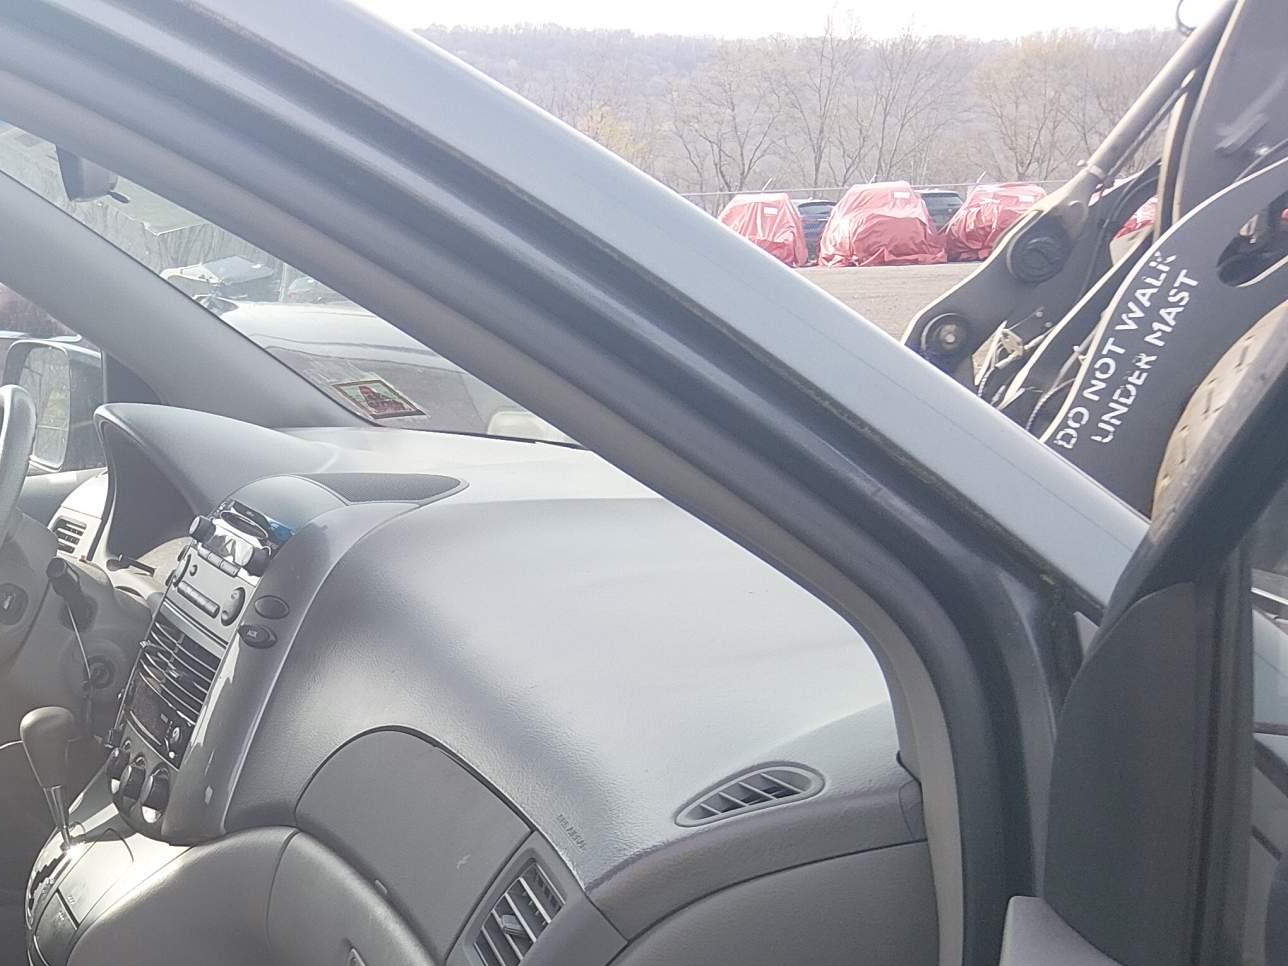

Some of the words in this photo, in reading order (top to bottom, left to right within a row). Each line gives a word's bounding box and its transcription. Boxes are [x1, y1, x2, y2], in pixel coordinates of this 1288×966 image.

[1053, 407, 1089, 449] DO
[1083, 338, 1126, 404] NOT
[1115, 251, 1177, 331] WALK
[1092, 353, 1157, 444] UNDER
[1145, 270, 1199, 347] MAST
